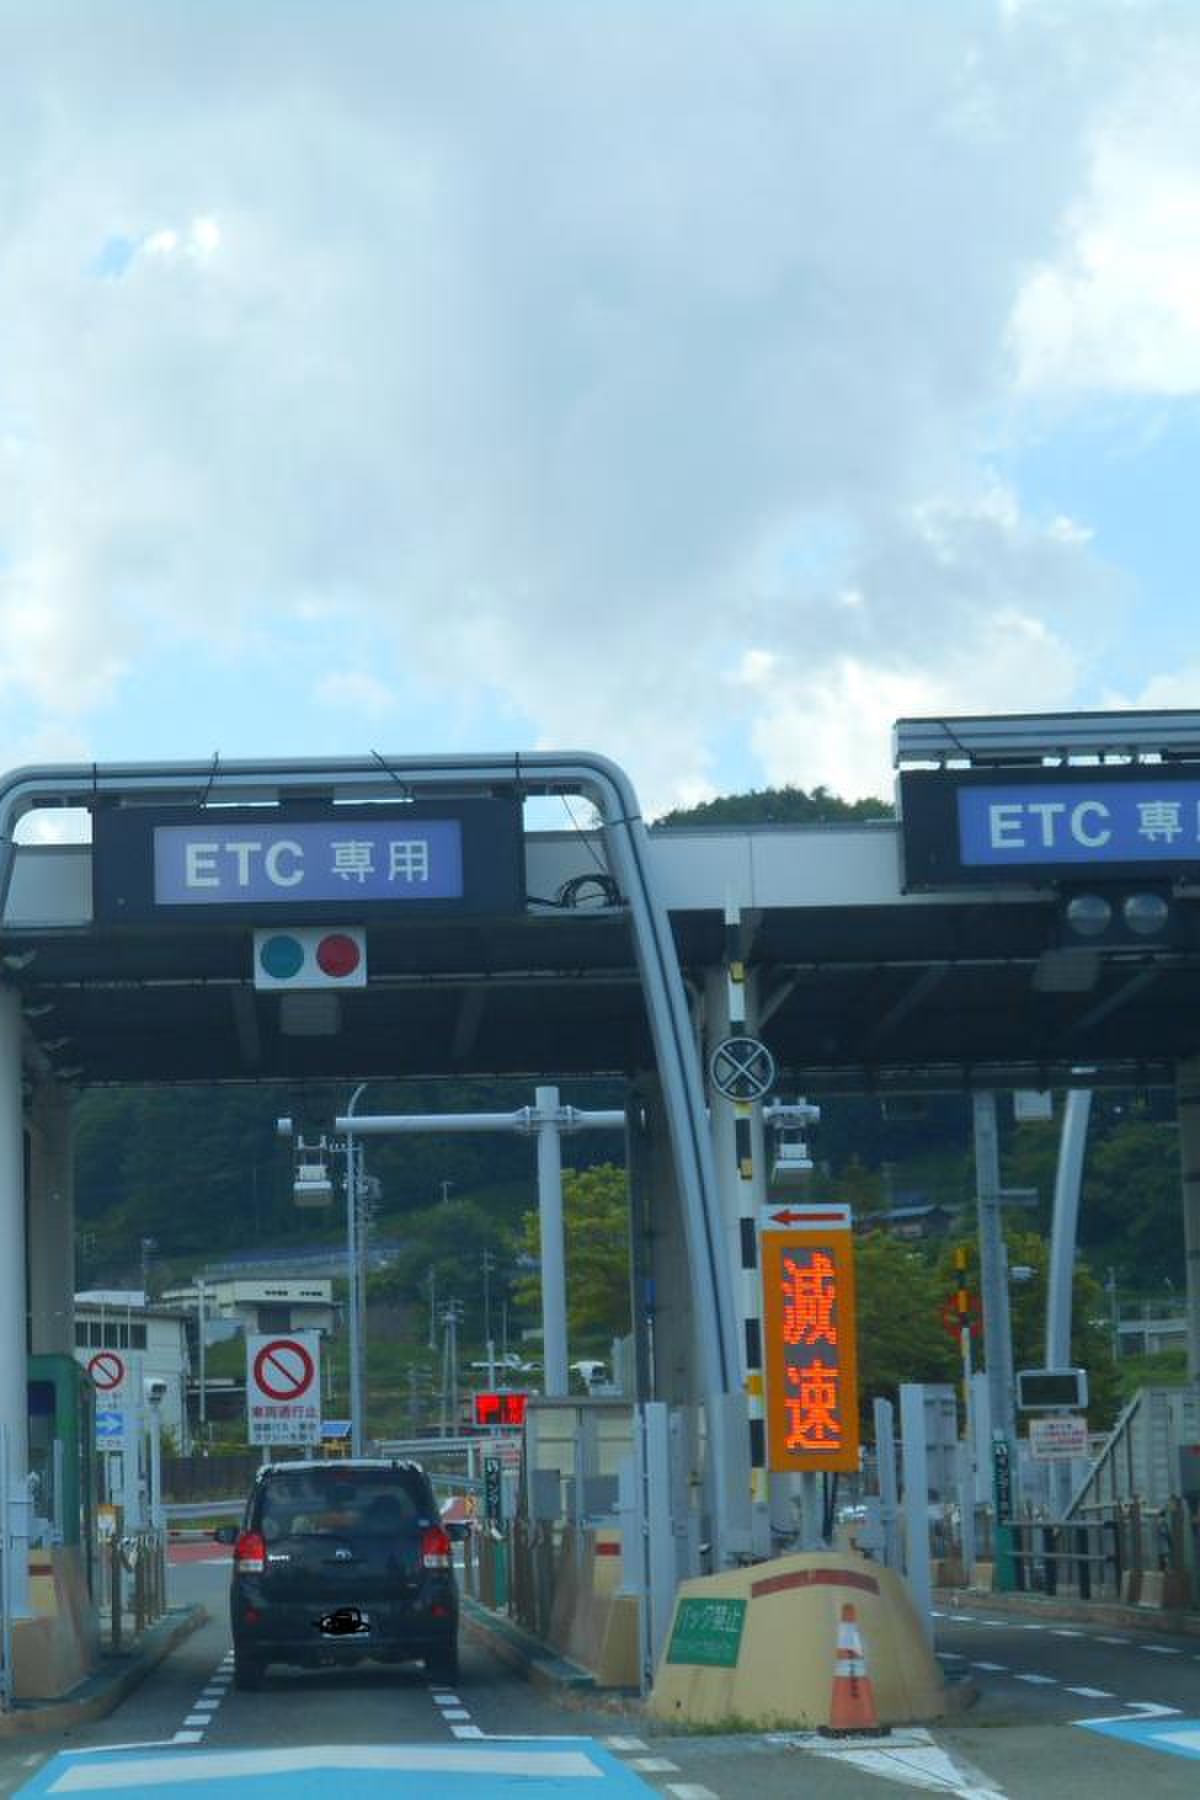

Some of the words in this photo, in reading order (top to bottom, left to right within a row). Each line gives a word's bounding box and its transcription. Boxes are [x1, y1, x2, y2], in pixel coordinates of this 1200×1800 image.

[988, 800, 1112, 849] ETC
[1136, 797, 1200, 844] 専
[185, 839, 305, 887] ETC
[329, 839, 430, 884] 専用
[781, 1251, 841, 1450] 減速
